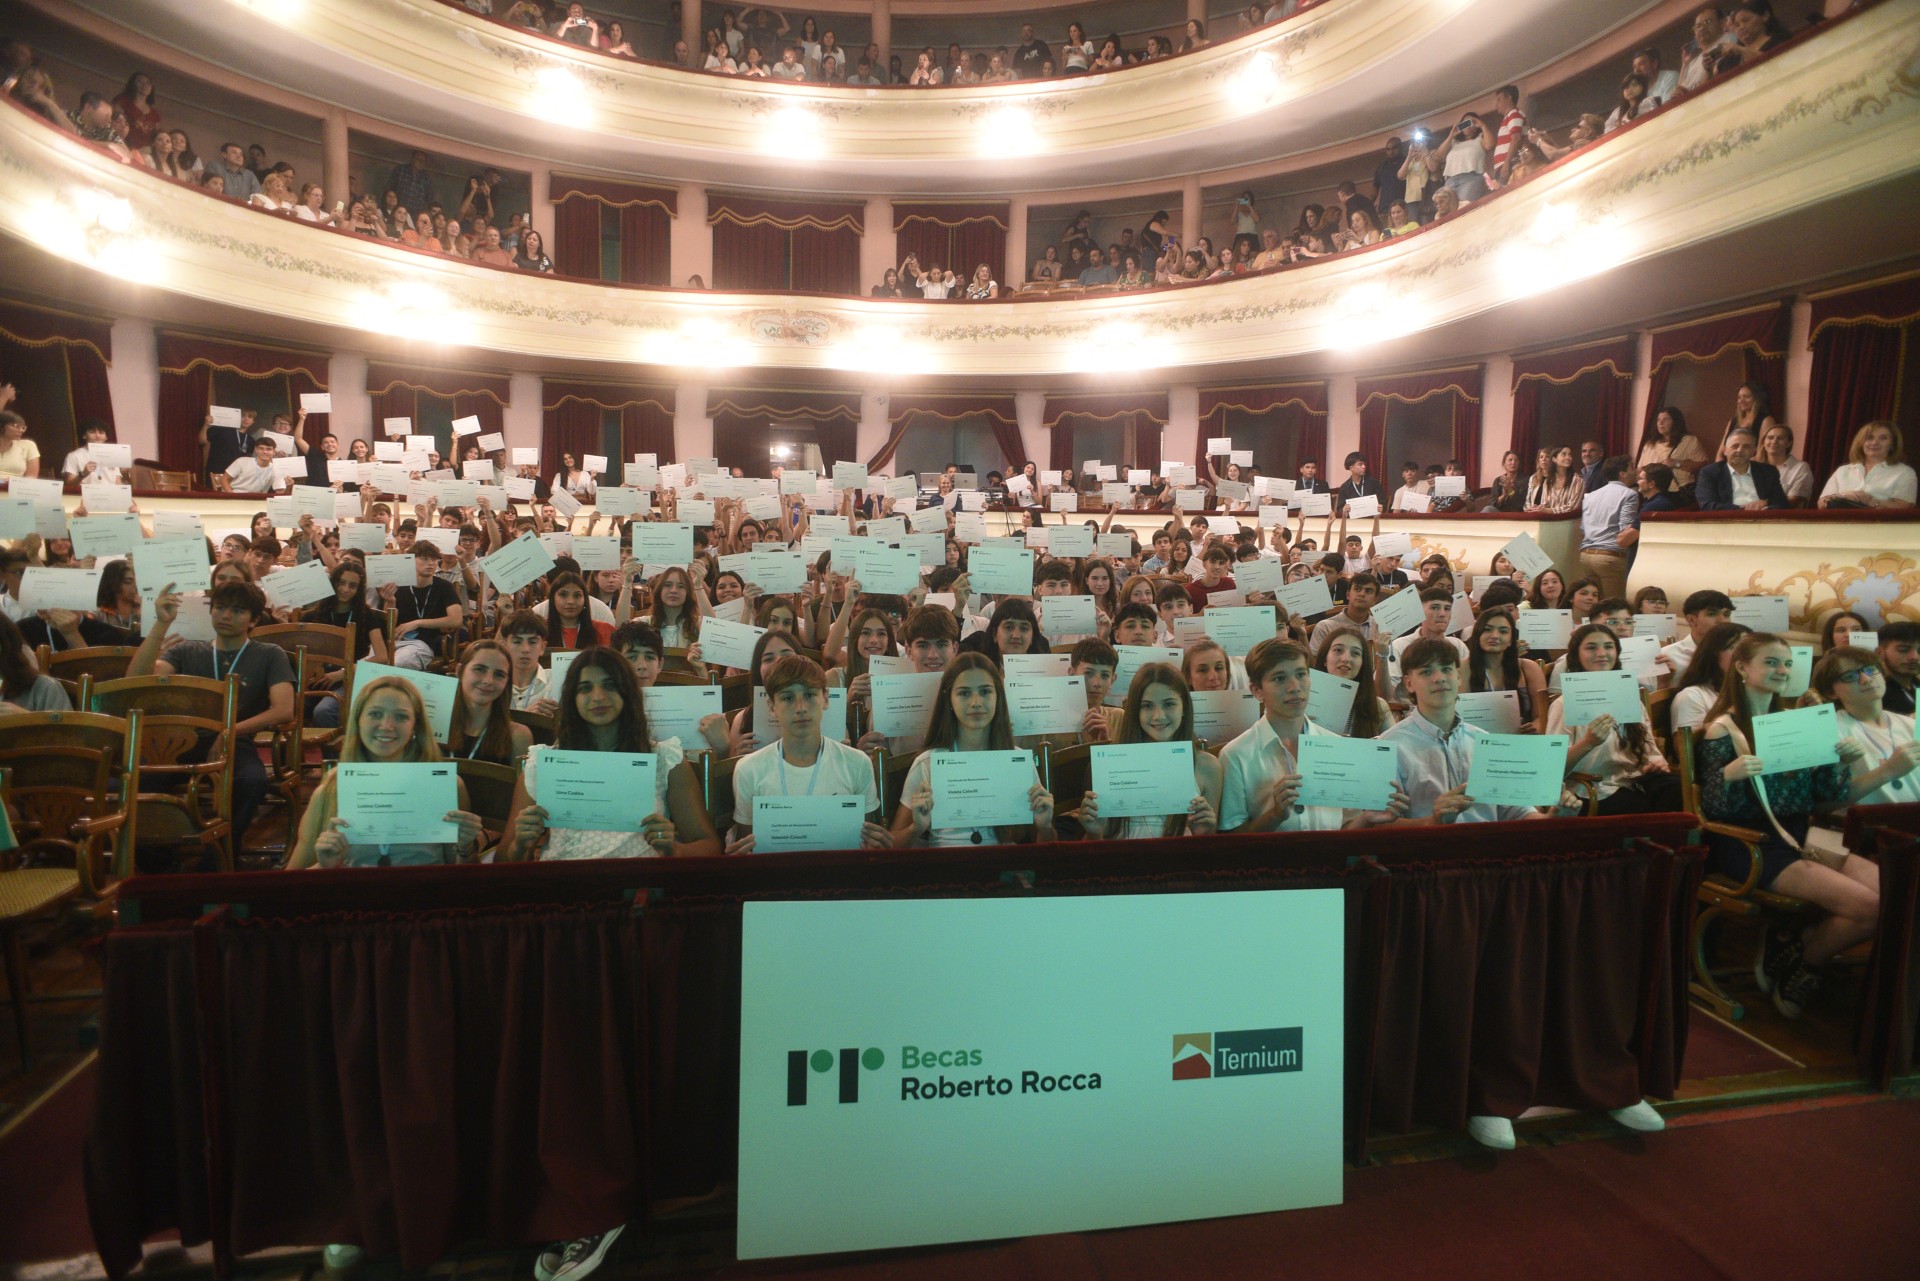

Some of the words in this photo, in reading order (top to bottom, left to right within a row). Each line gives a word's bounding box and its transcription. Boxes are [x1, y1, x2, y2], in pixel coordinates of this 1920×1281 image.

[902, 1046, 983, 1069] Becas
[1218, 1045, 1297, 1071] Ternium
[901, 1075, 1013, 1101] Roberto
[1021, 1070, 1102, 1094] Rocca
